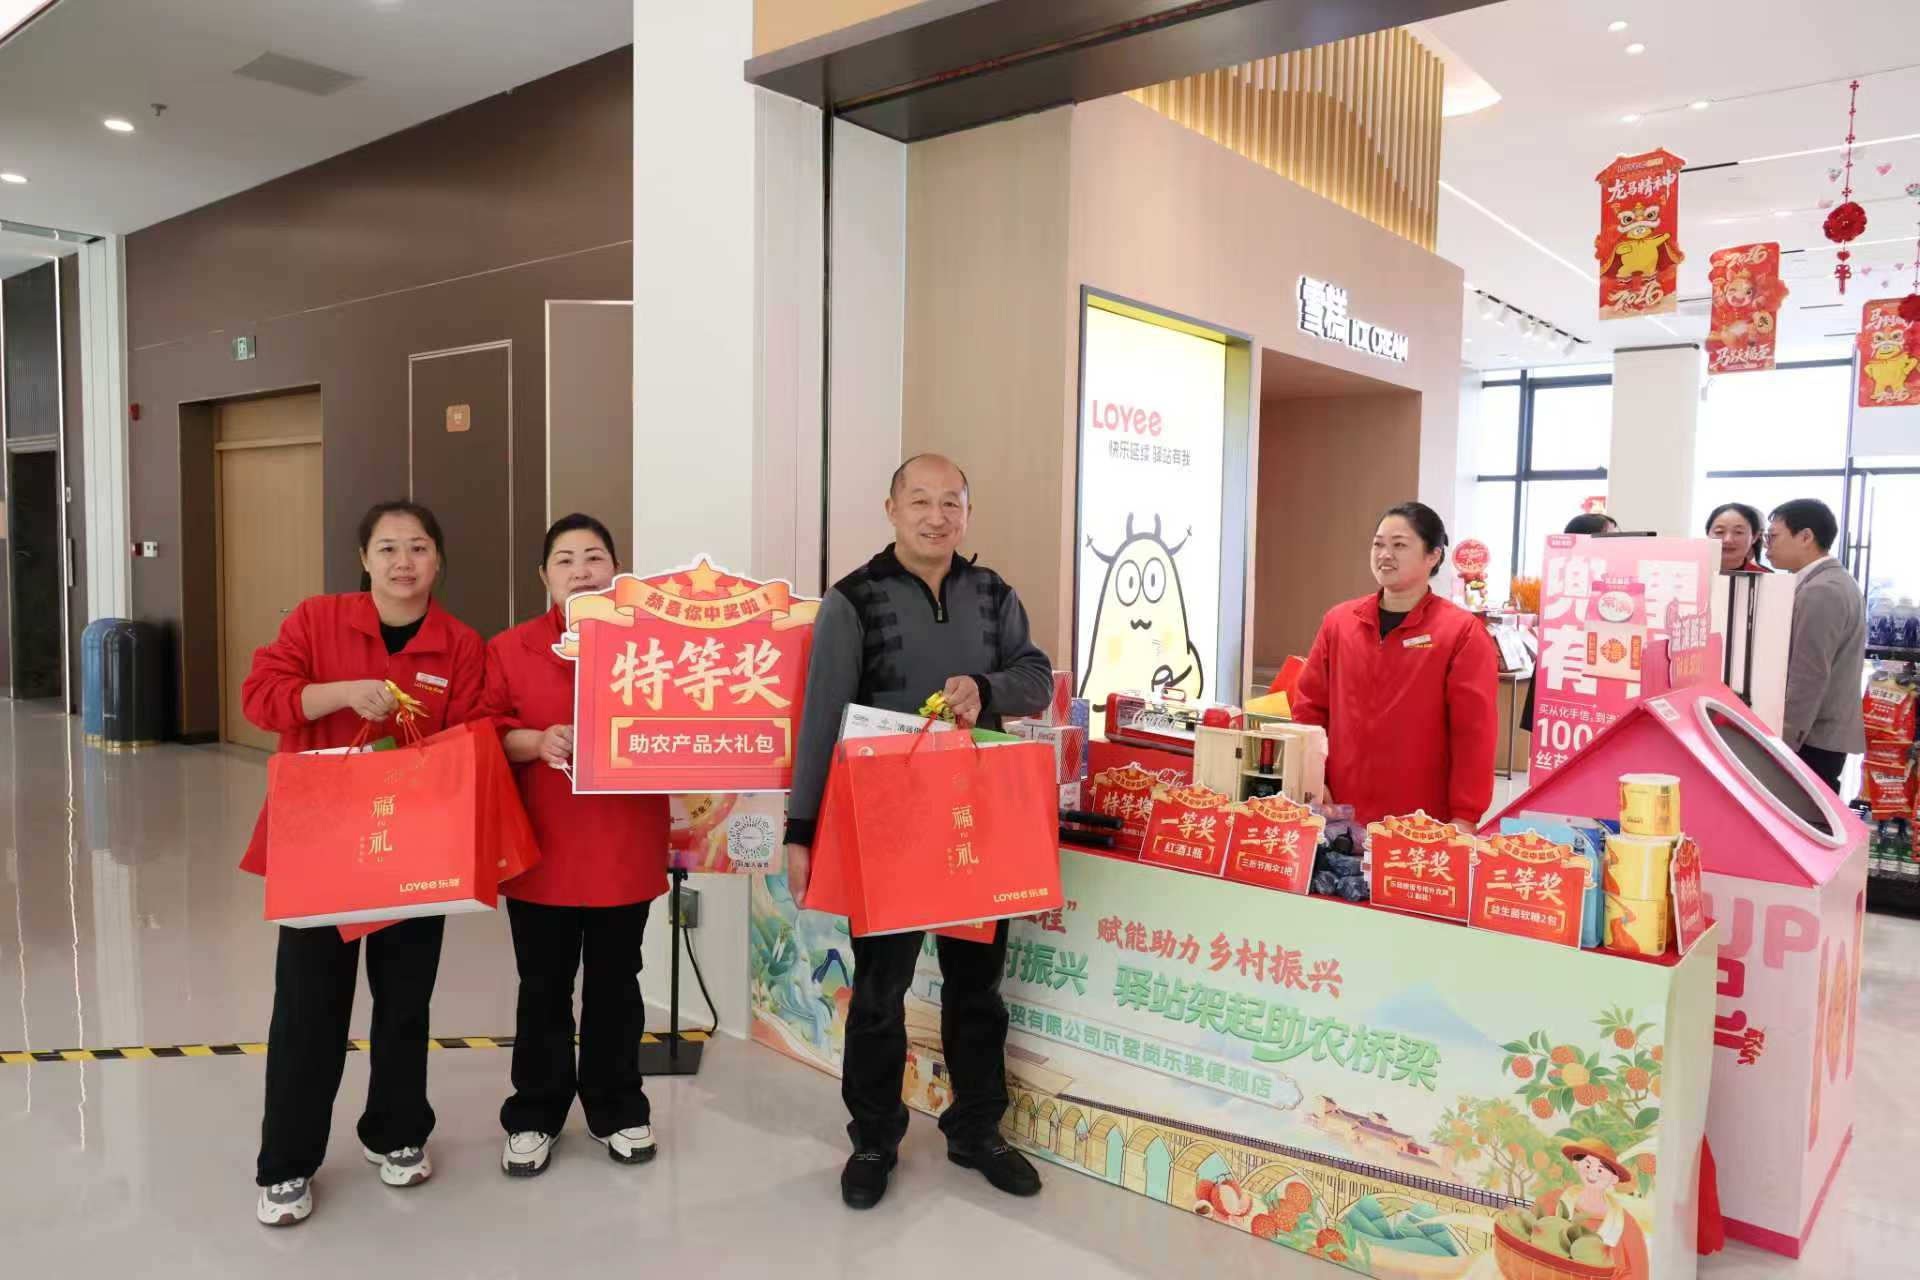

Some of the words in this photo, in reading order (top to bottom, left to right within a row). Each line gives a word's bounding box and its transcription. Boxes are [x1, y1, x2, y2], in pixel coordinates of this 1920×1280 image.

[1607, 169, 1676, 203] 龙马精神
[610, 637, 792, 711] 特等奖
[629, 734, 775, 754] 助农产品大礼包
[1537, 718, 1606, 752] 100
[1161, 812, 1217, 843] 一等奖
[1240, 827, 1300, 859] 三等奖
[1384, 847, 1454, 882] 三等奖
[1486, 867, 1565, 906] 三等奖
[1096, 916, 1344, 998] 赋能助力乡村振兴
[1113, 962, 1442, 1091] 驿站架起助农桥梁
[1002, 1002, 1273, 1100] 贸有限公司瓦窑岗乐驿便利店
